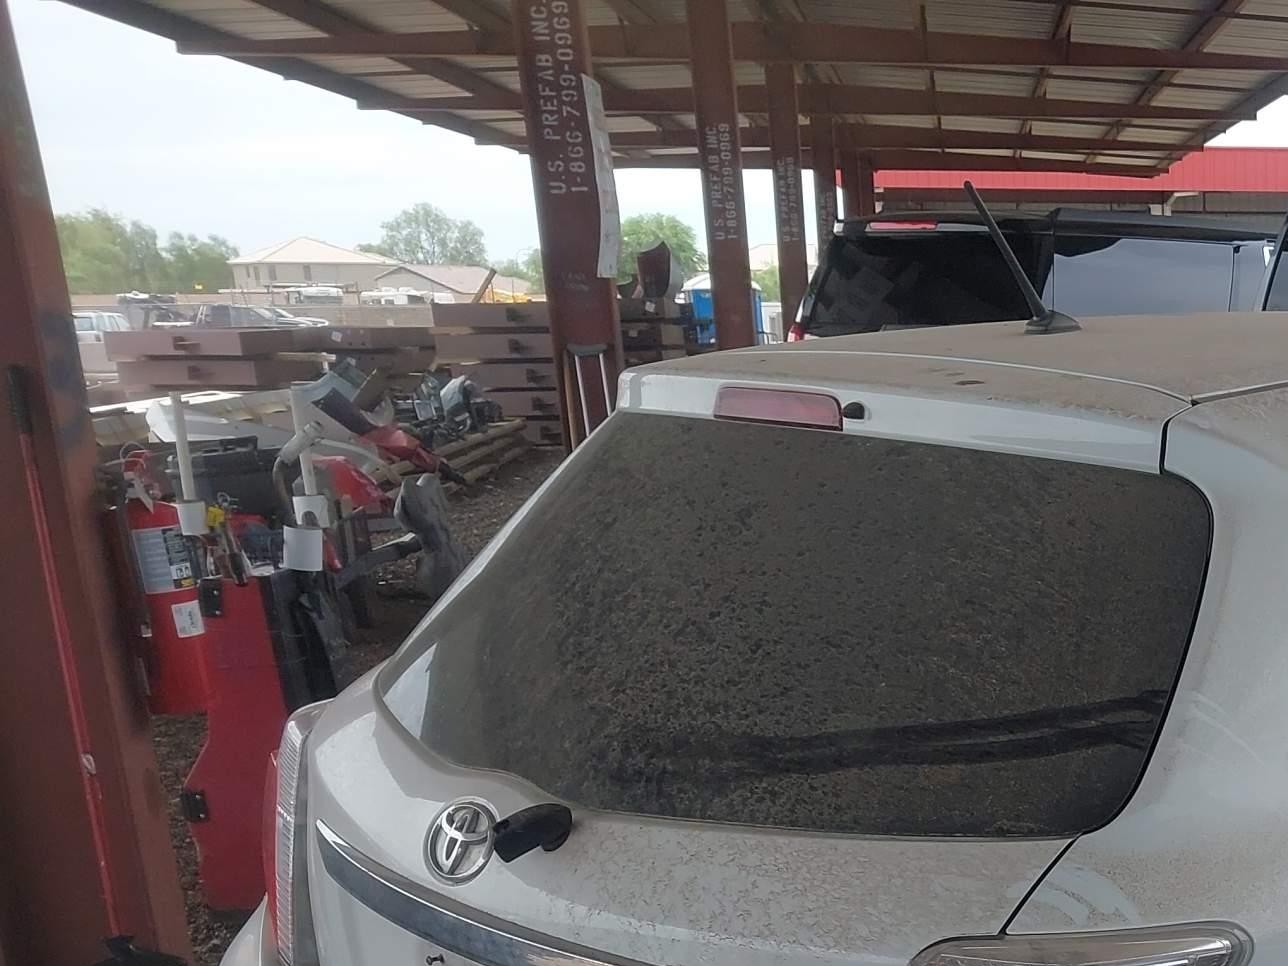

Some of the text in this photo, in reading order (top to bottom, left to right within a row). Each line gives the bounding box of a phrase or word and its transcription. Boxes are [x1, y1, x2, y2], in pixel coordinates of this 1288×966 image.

[530, 0, 567, 195] U.S. PREFAB INC.
[552, 1, 589, 194] 1-866-799-0969
[708, 154, 723, 208] PREFAB
